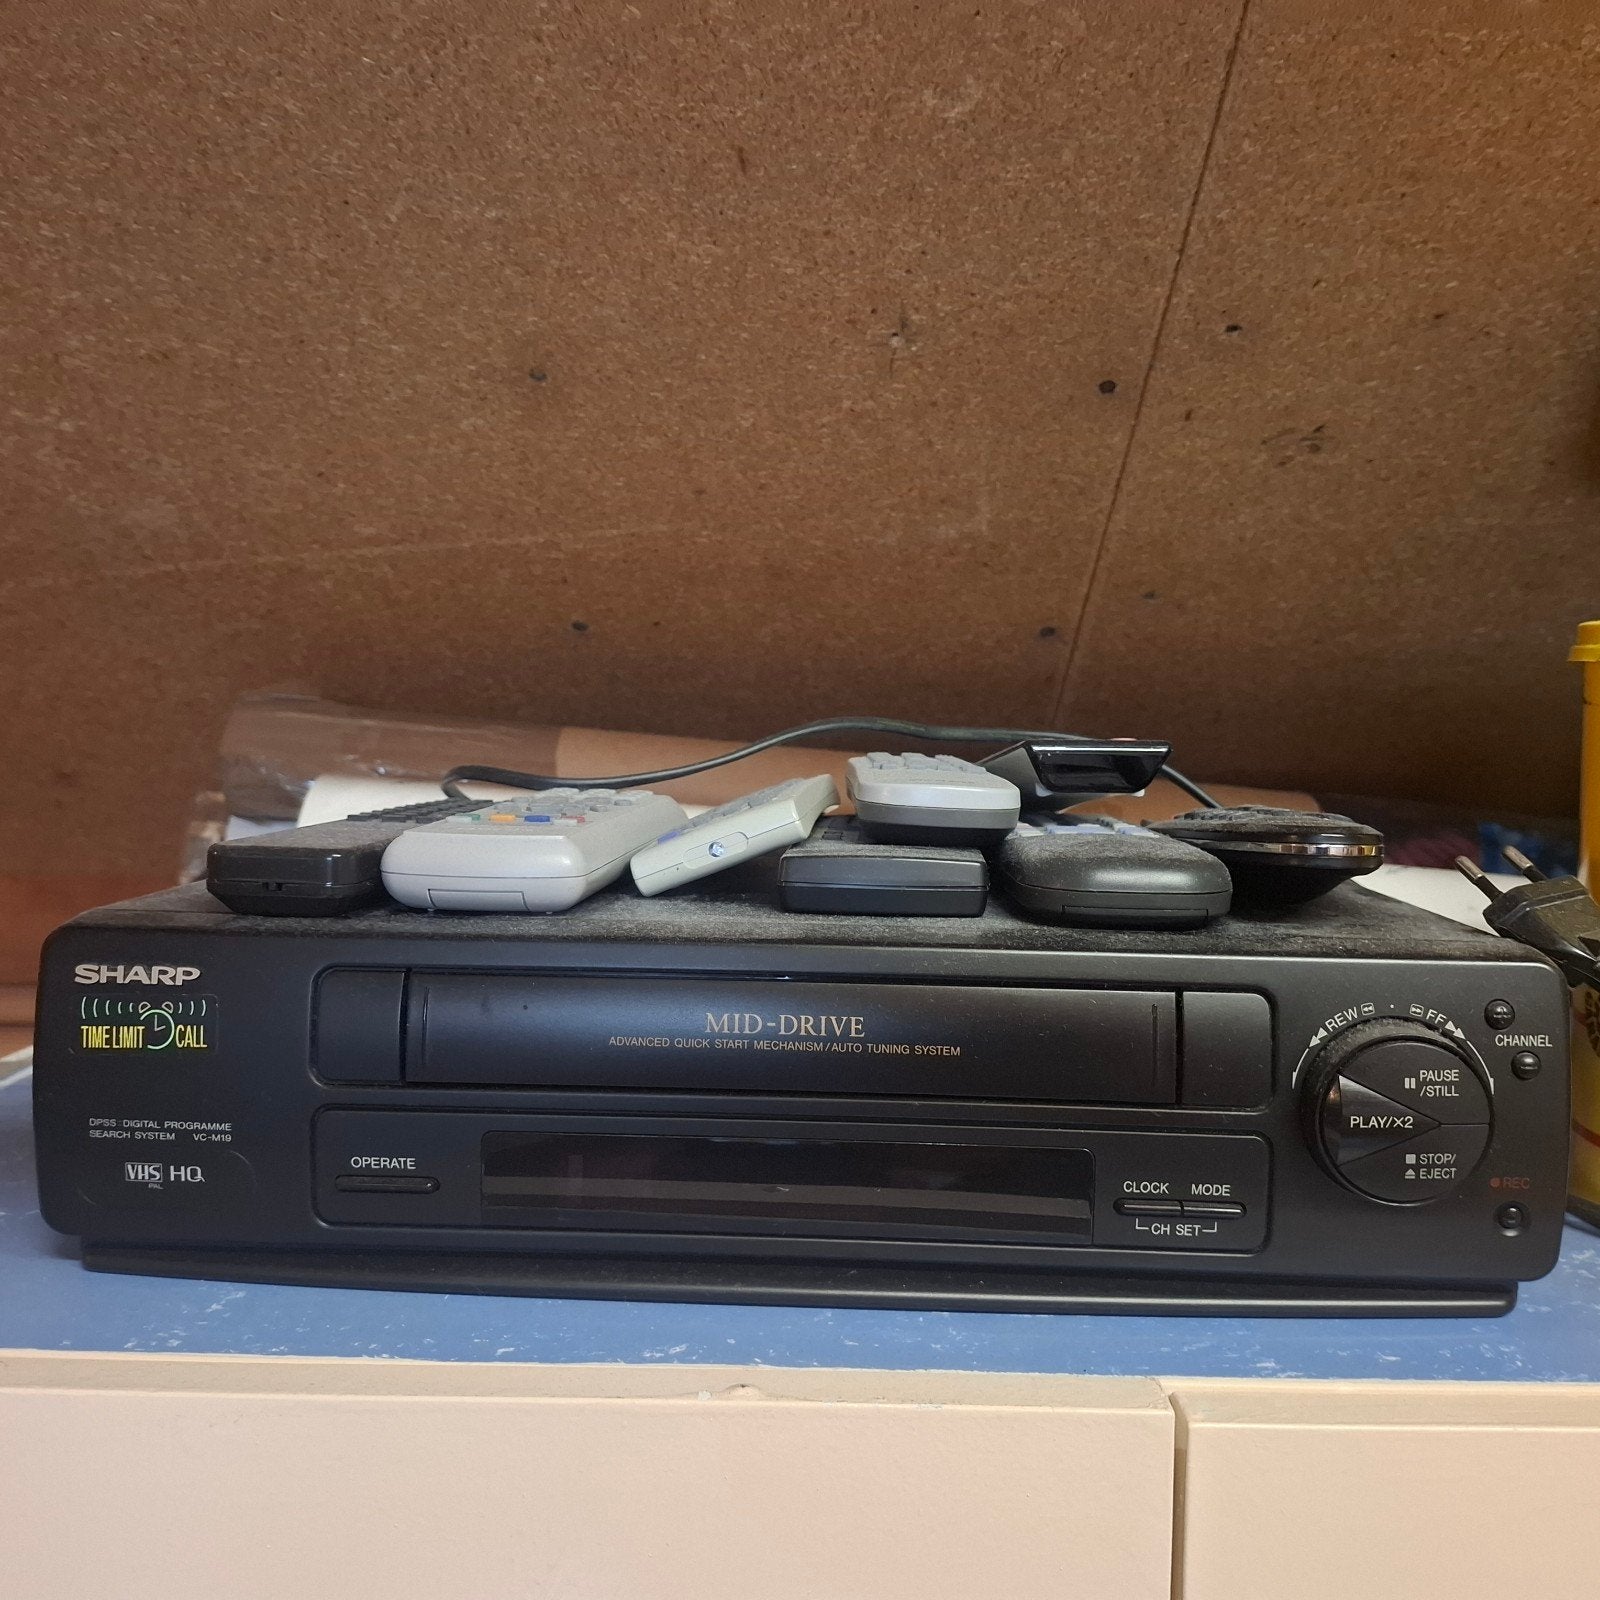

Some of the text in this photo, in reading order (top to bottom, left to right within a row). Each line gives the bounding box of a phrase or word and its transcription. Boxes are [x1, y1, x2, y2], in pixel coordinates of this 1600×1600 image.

[74, 964, 201, 986] SHARP
[1325, 1006, 1358, 1032] REW
[1426, 1009, 1447, 1025] FF
[705, 1012, 865, 1037] MID-DRIVE
[81, 1024, 208, 1049] TIME LIMIT CALL
[1495, 1034, 1553, 1047] CHANNEL
[609, 1037, 670, 1047] ADVANCED
[674, 1038, 710, 1048] QUICK
[715, 1039, 749, 1049] START
[867, 1043, 910, 1055] TUNING
[914, 1045, 961, 1056] SYSTEM
[1419, 1069, 1460, 1082] PAUSE
[1420, 1085, 1460, 1097] /STILL
[122, 1119, 161, 1129] DIGITAL
[164, 1120, 232, 1131] PROGRAMME
[89, 1130, 232, 1142] SEARCH SYSTEM VC-M19
[350, 1156, 416, 1170] OPERATE
[1419, 1154, 1456, 1165] STOP/
[126, 1164, 205, 1182] VHS HQ
[1419, 1169, 1457, 1179] EJECT
[1123, 1181, 1169, 1194] CLOCK
[1503, 1177, 1530, 1189] REC
[1191, 1184, 1231, 1196] MODE
[1151, 1223, 1201, 1236] CH SET
